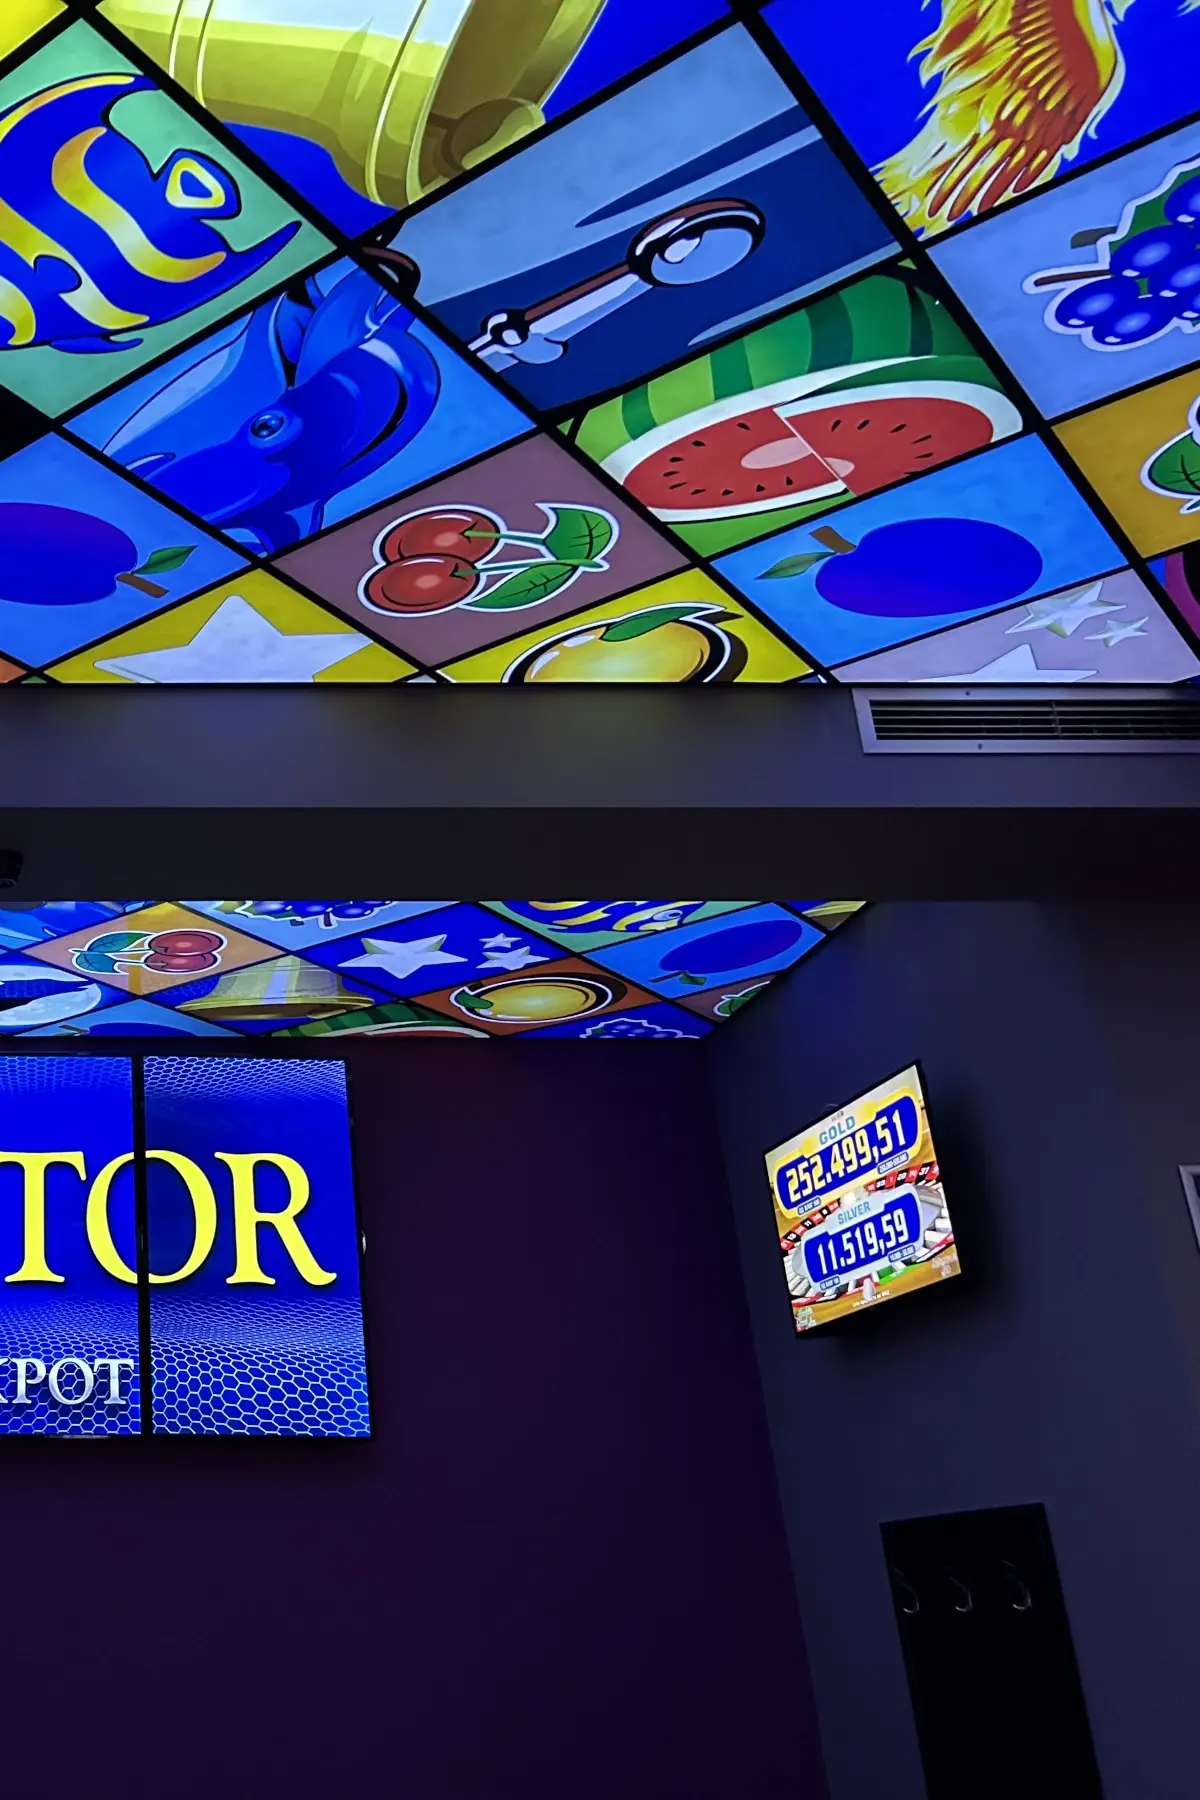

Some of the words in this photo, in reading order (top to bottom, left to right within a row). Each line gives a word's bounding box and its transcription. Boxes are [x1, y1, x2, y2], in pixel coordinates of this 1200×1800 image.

[819, 1115, 856, 1145] GOLD
[785, 1109, 907, 1203] 252.499,51
[837, 1200, 871, 1225] SILVER
[817, 1208, 909, 1275] 11.519,59
